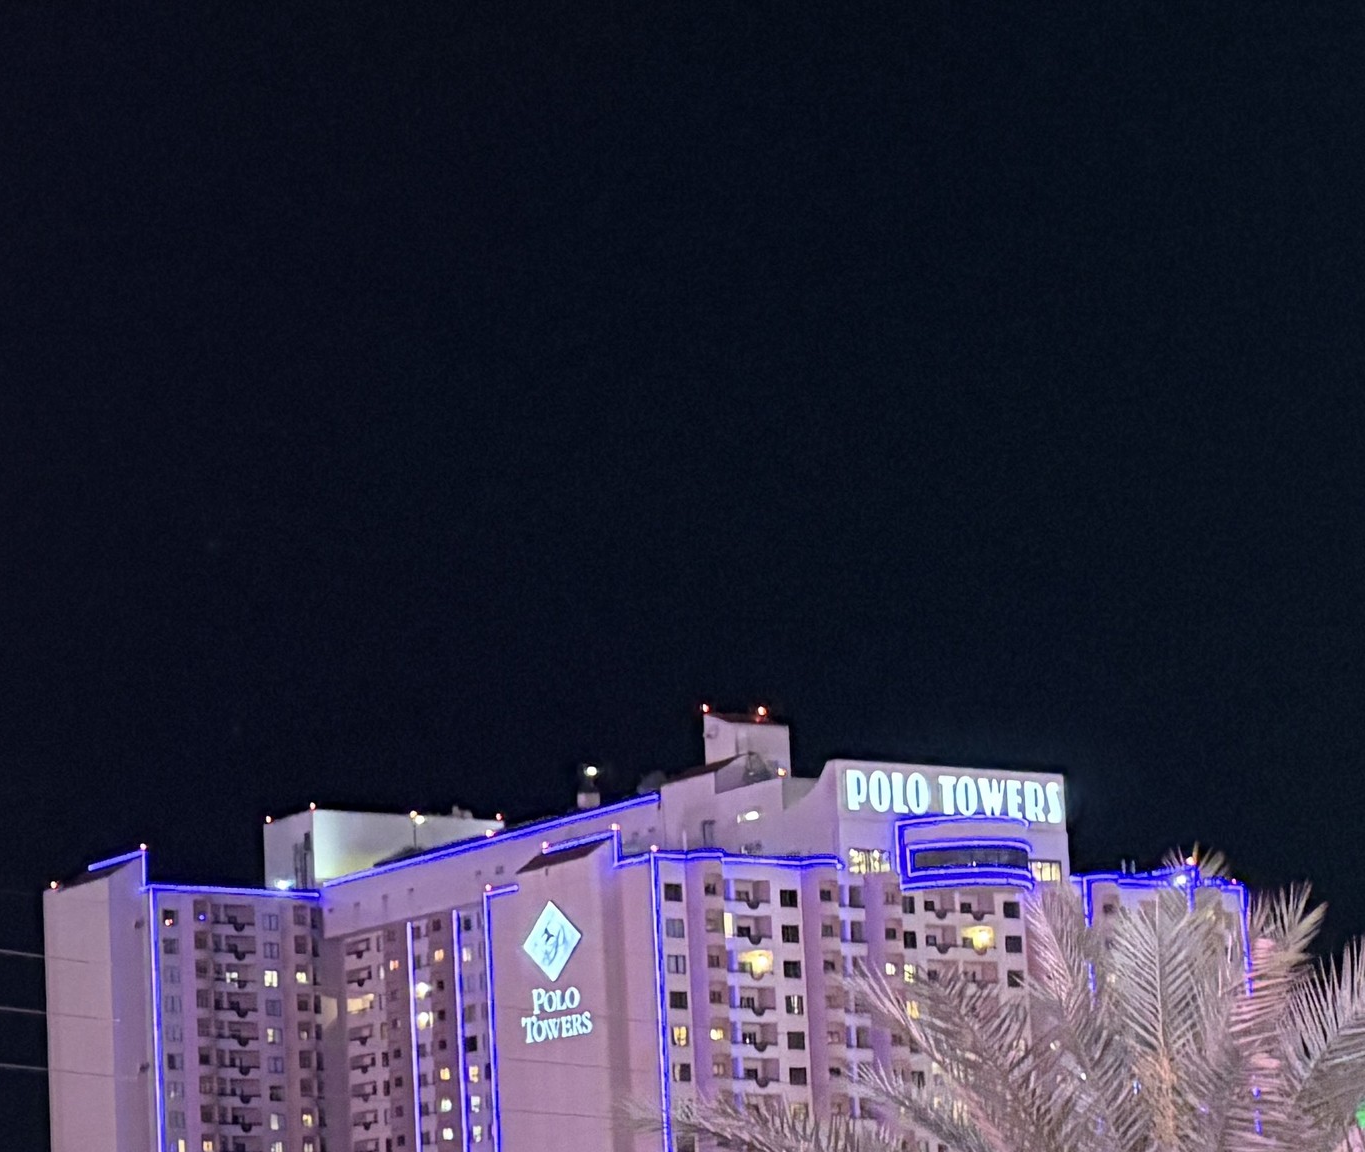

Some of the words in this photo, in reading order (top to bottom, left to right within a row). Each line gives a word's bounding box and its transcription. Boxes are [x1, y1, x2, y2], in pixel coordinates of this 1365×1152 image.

[845, 769, 931, 815] POLO
[937, 775, 1063, 824] TOWERS
[531, 986, 581, 1015] POLO
[521, 1011, 593, 1043] TOWERS
